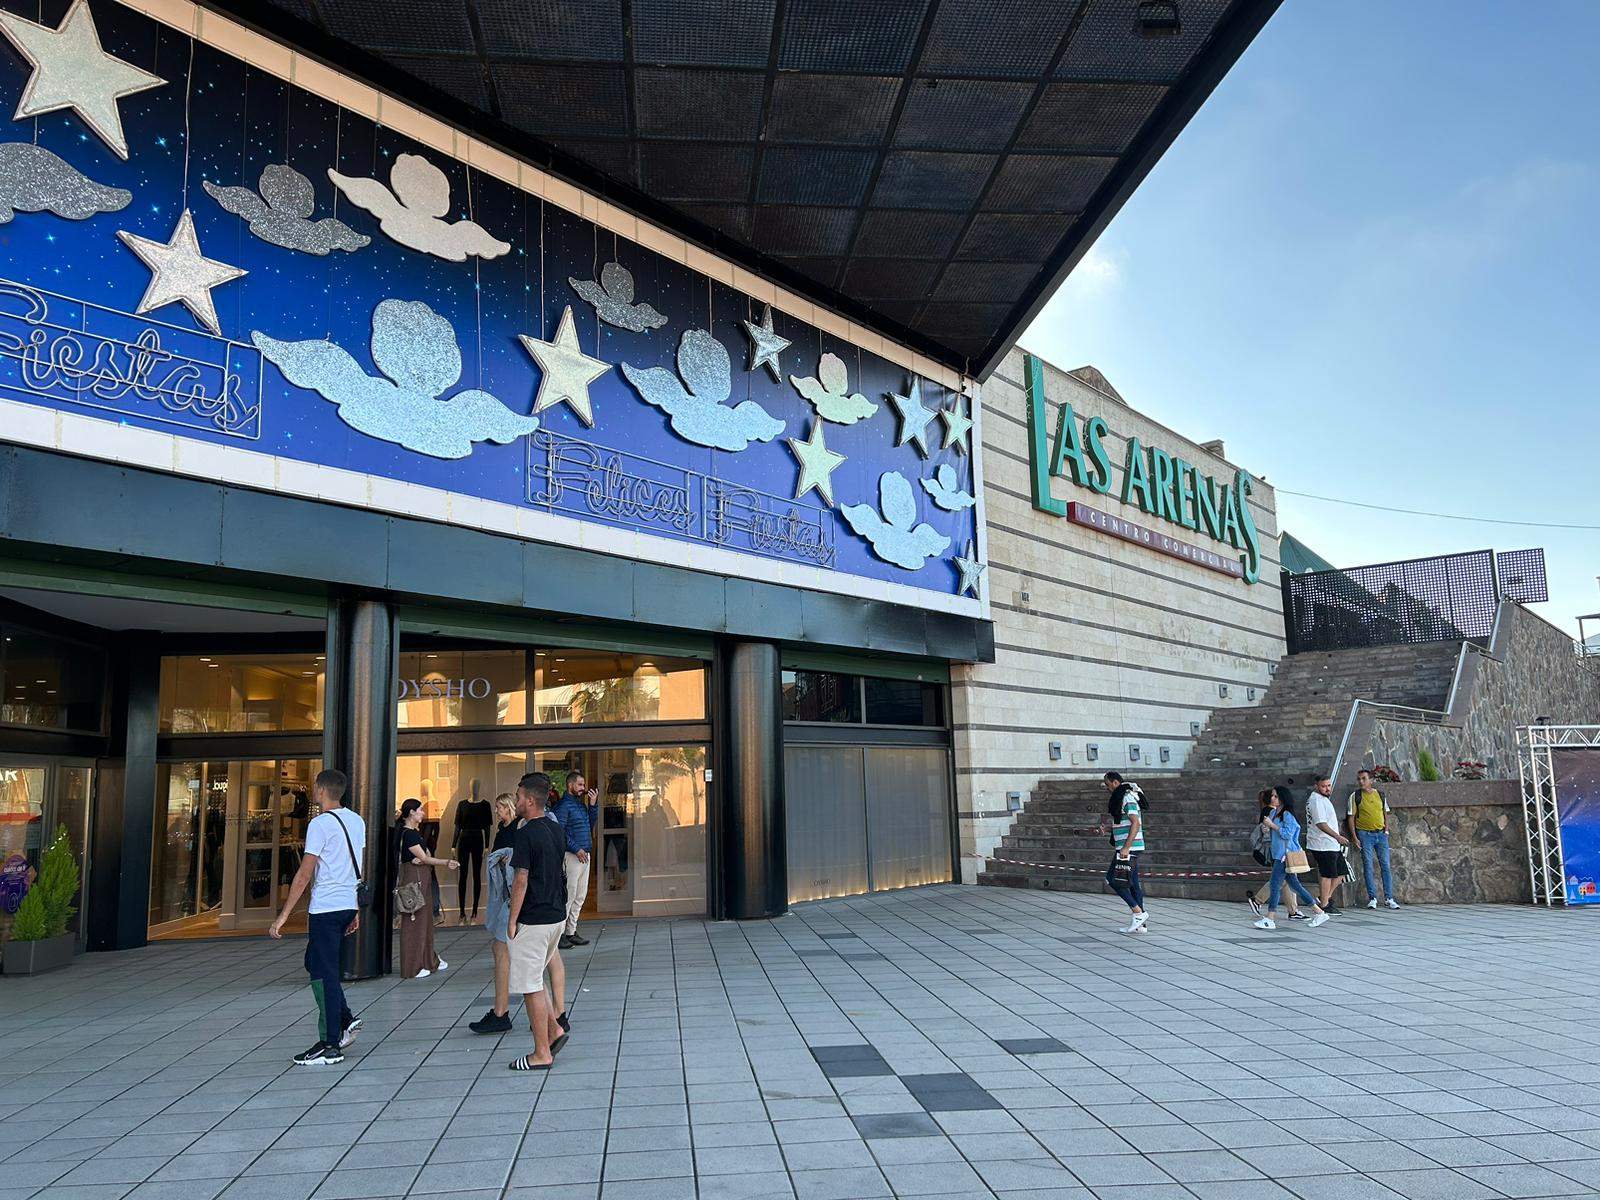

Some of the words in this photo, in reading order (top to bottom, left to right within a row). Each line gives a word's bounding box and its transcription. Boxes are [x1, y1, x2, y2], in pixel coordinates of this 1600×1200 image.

[533, 431, 698, 530] Felices
[708, 481, 835, 565] Fiestas
[1024, 354, 1112, 517] LAS
[1120, 436, 1261, 585] ARENAS
[1090, 511, 1150, 543] CENTRO
[1163, 537, 1236, 573] COMERCIAL
